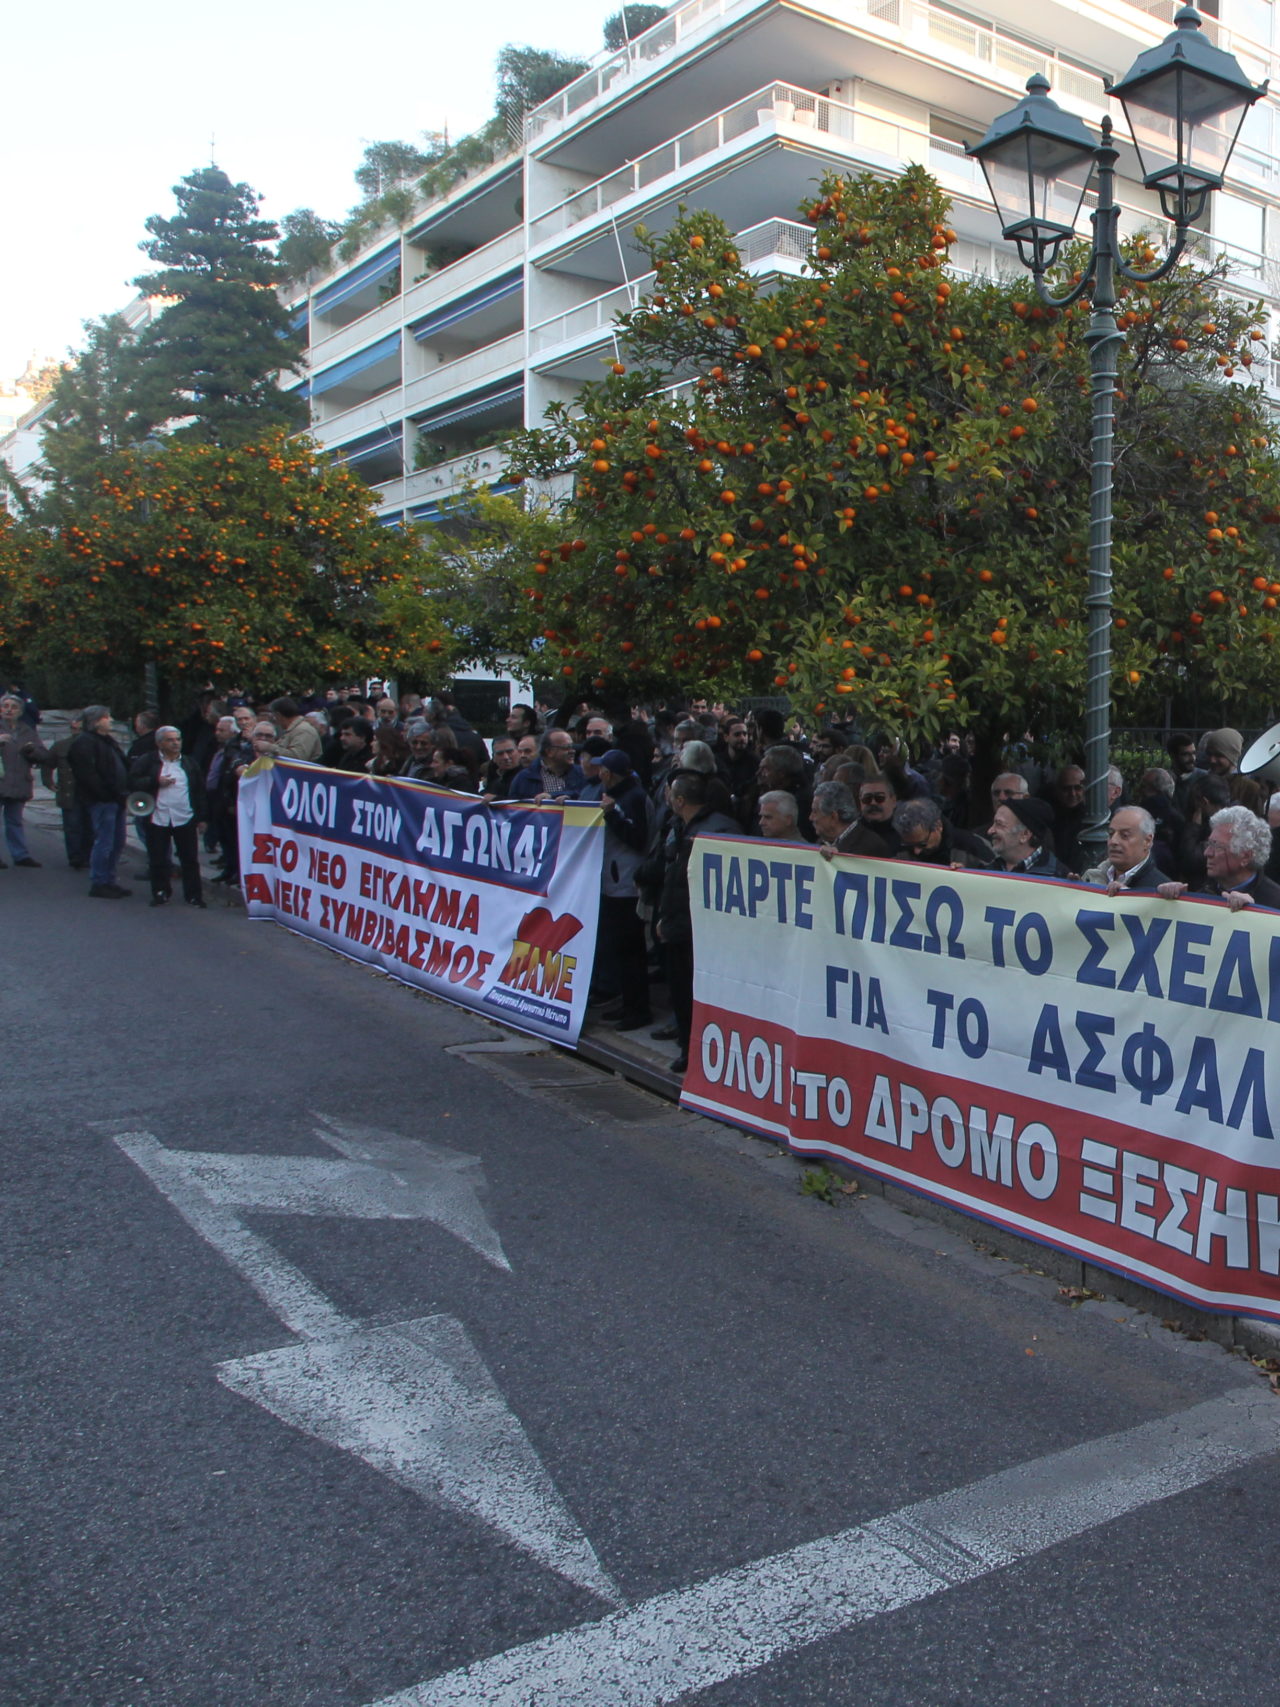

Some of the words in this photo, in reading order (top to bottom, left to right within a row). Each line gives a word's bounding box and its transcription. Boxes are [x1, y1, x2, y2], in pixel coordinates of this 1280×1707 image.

[282, 778, 337, 828] ΟΛΟΙ
[351, 799, 401, 844] ΣΤΟΝ
[416, 807, 548, 878] ΑΓΩΝΑ!
[252, 833, 298, 872] ΣΤΟ
[308, 847, 347, 889] ΝΕΟ
[359, 861, 480, 935] ΕΓΚΛΗΜΑ
[702, 853, 815, 930] ΠΑΡΤΕ
[833, 871, 966, 960] ΠΙΣΩ
[984, 905, 1053, 976] ΤΟ
[319, 894, 495, 991] ΣΥΜΒΙΒΑΣΜΟΣ
[826, 965, 889, 1035] ΓΙΑ
[927, 989, 989, 1059] ΤΟ
[701, 1022, 783, 1104] ΟΛΟΙ
[864, 1075, 1059, 1200] ΔΡΟΜΟ
